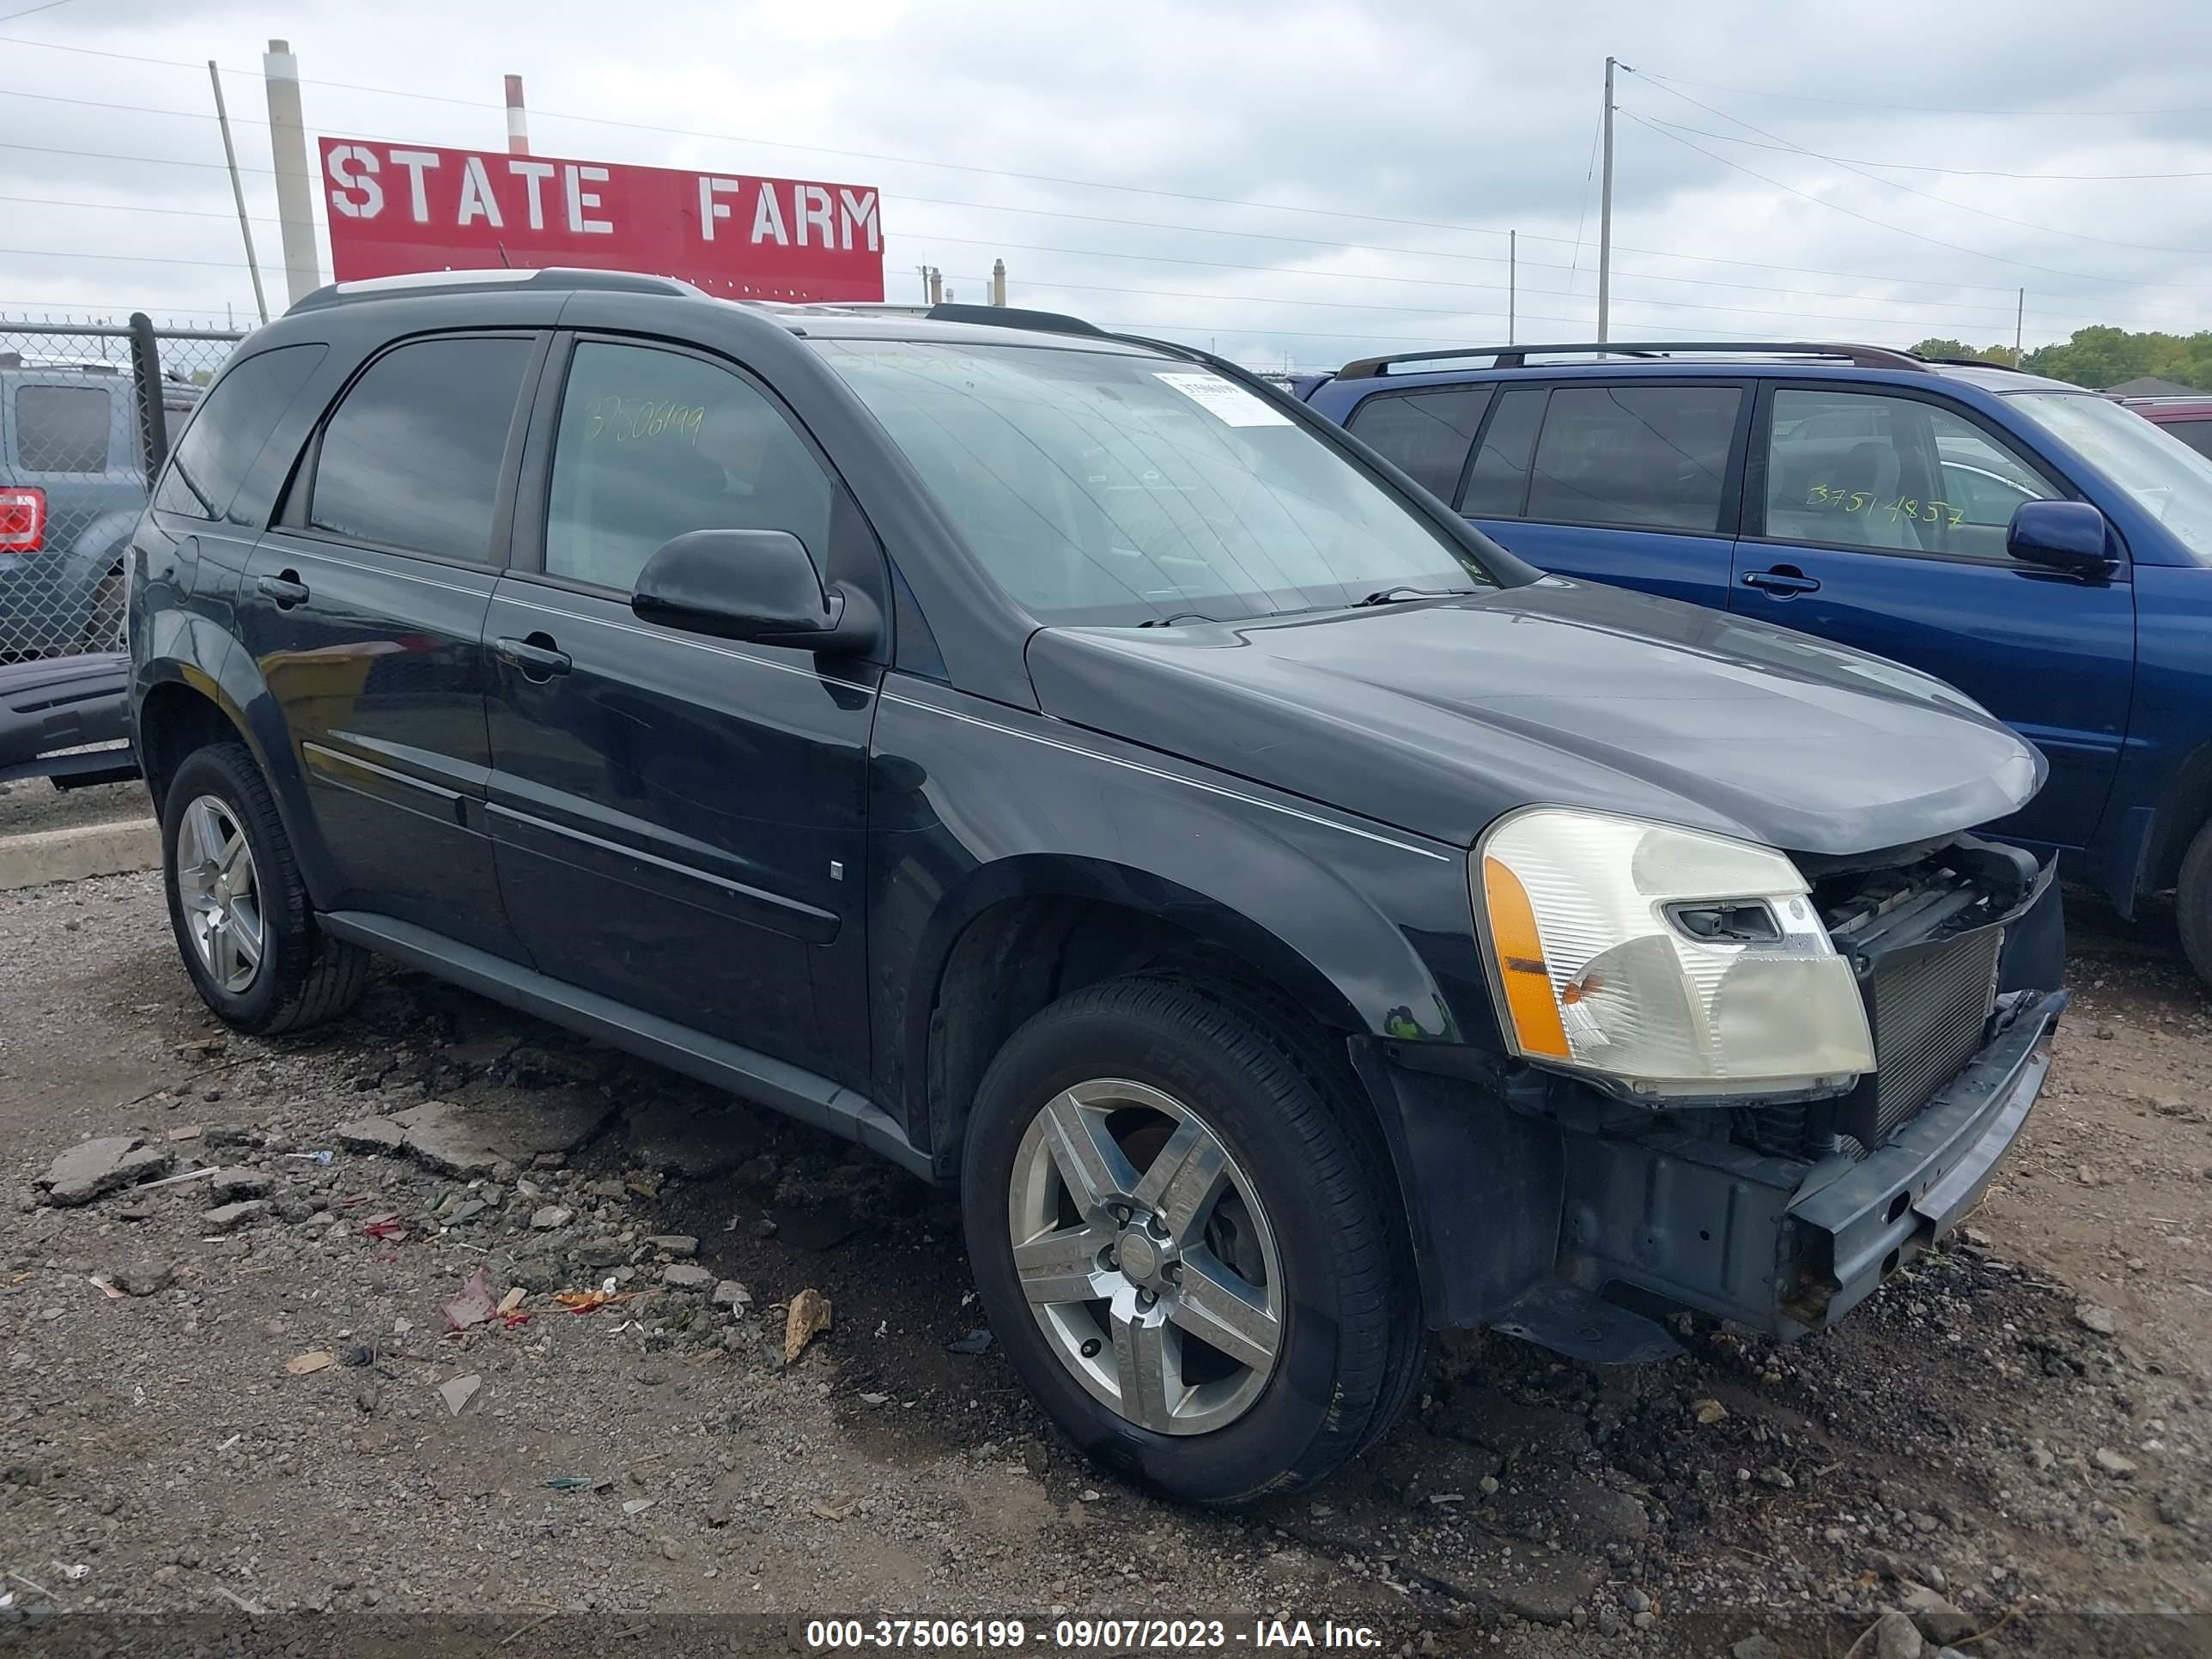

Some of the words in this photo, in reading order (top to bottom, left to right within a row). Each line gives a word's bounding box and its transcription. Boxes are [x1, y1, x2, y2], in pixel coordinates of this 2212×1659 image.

[326, 144, 614, 234] STATE
[698, 176, 878, 252] FARM
[1806, 483, 1965, 526] 37514857
